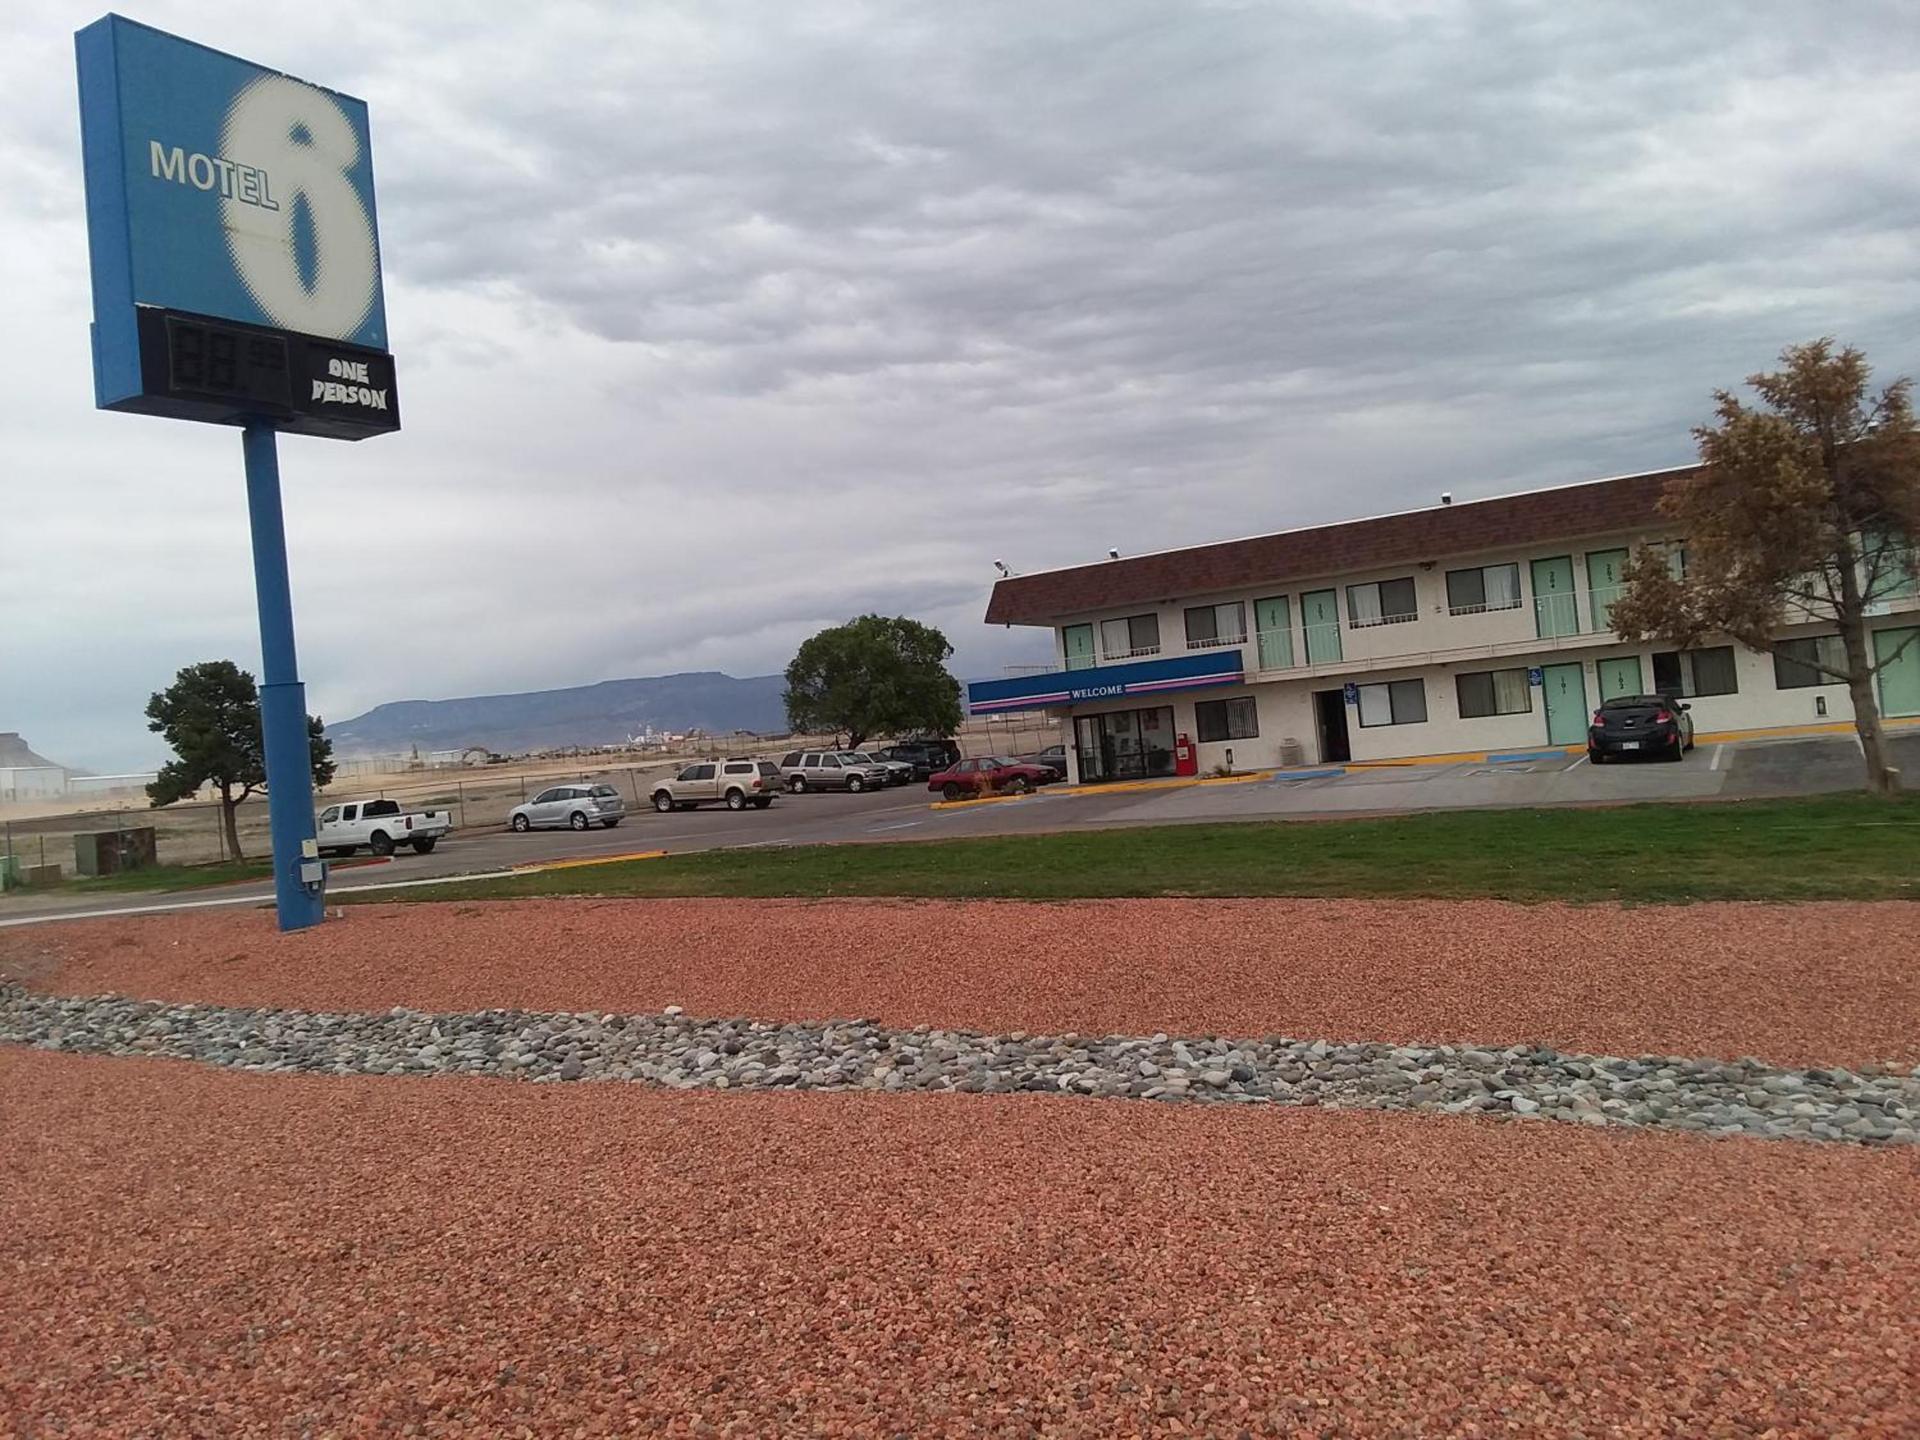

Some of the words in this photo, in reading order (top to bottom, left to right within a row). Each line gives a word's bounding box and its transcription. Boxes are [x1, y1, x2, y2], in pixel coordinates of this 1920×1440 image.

[150, 139, 280, 211] MOTEL
[216, 72, 378, 341] 6
[328, 358, 370, 385] ONE
[311, 378, 388, 411] PERSON
[1071, 684, 1124, 699] WELCOME
